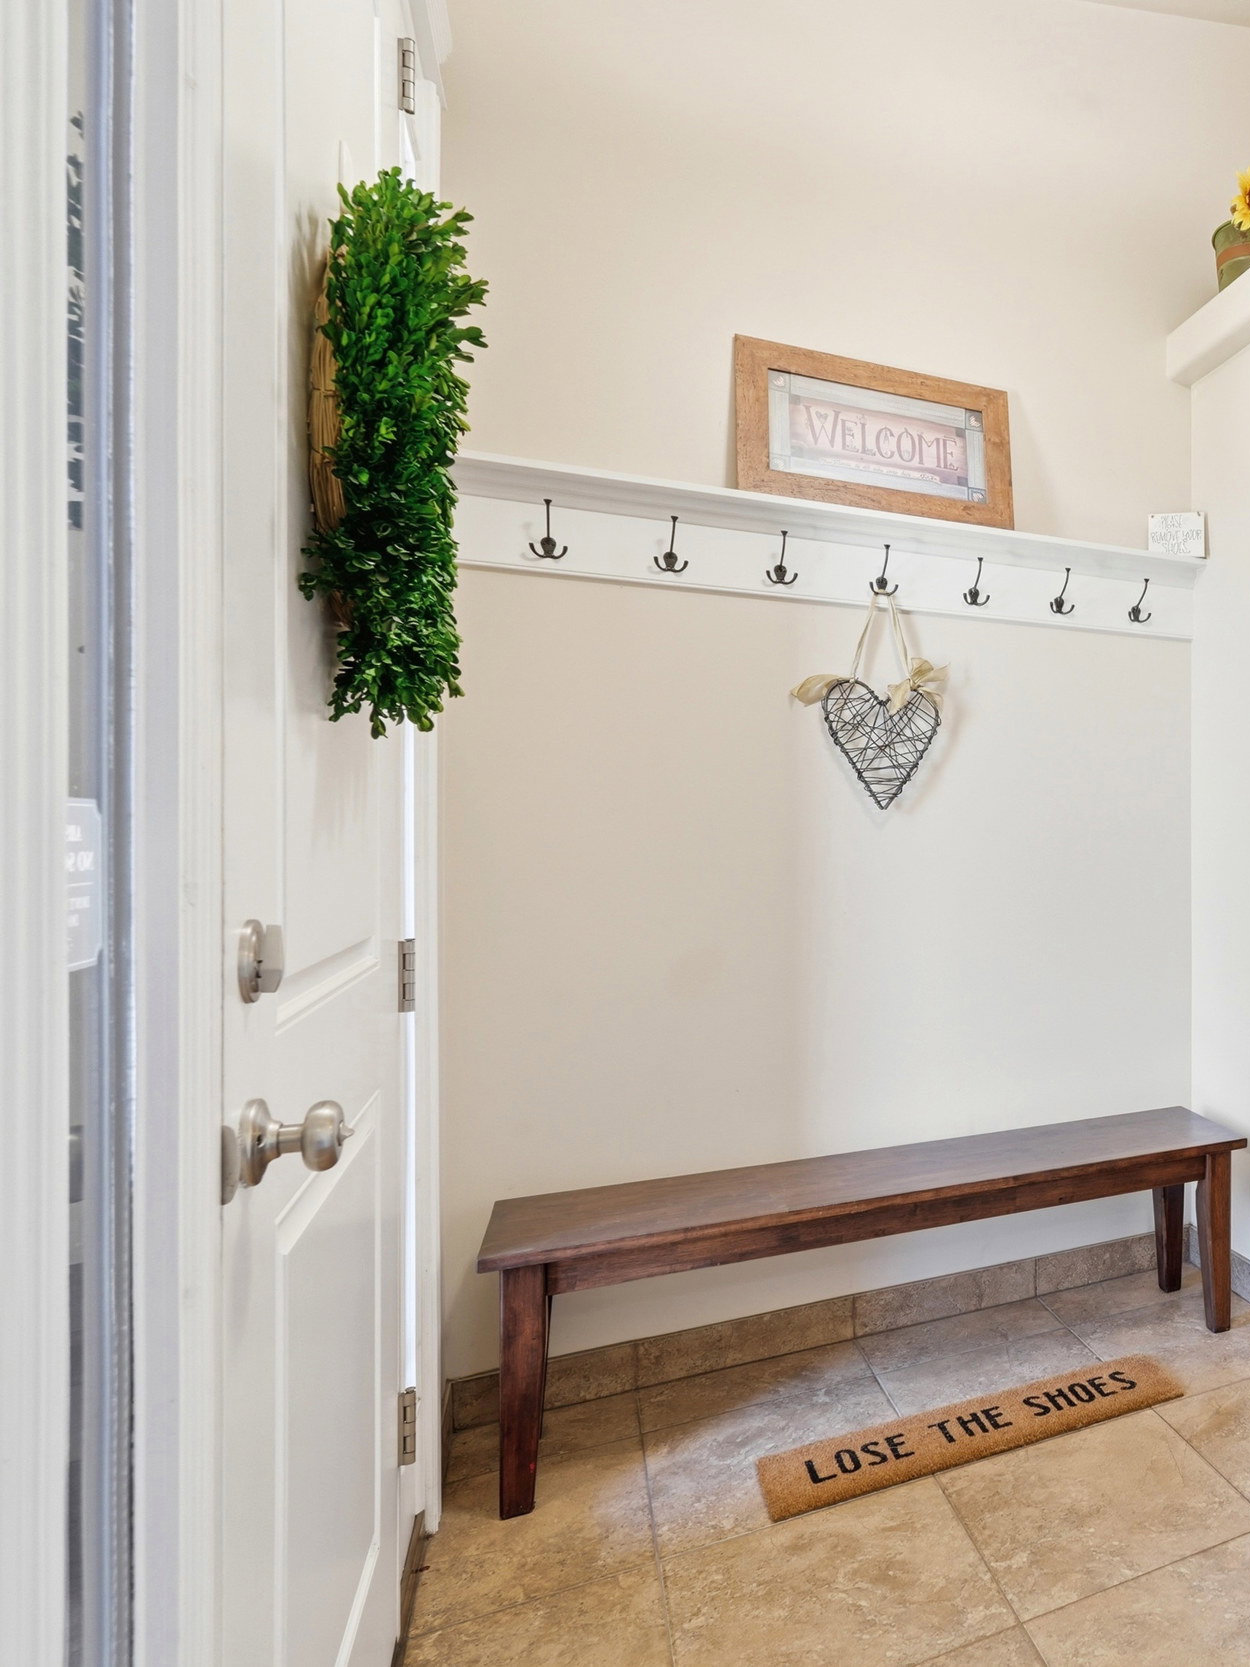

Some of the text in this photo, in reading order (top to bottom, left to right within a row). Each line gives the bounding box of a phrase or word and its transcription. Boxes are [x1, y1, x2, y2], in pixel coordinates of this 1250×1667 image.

[803, 403, 960, 472] WELCOME
[804, 1370, 1138, 1485] LOSE THE SHOES
